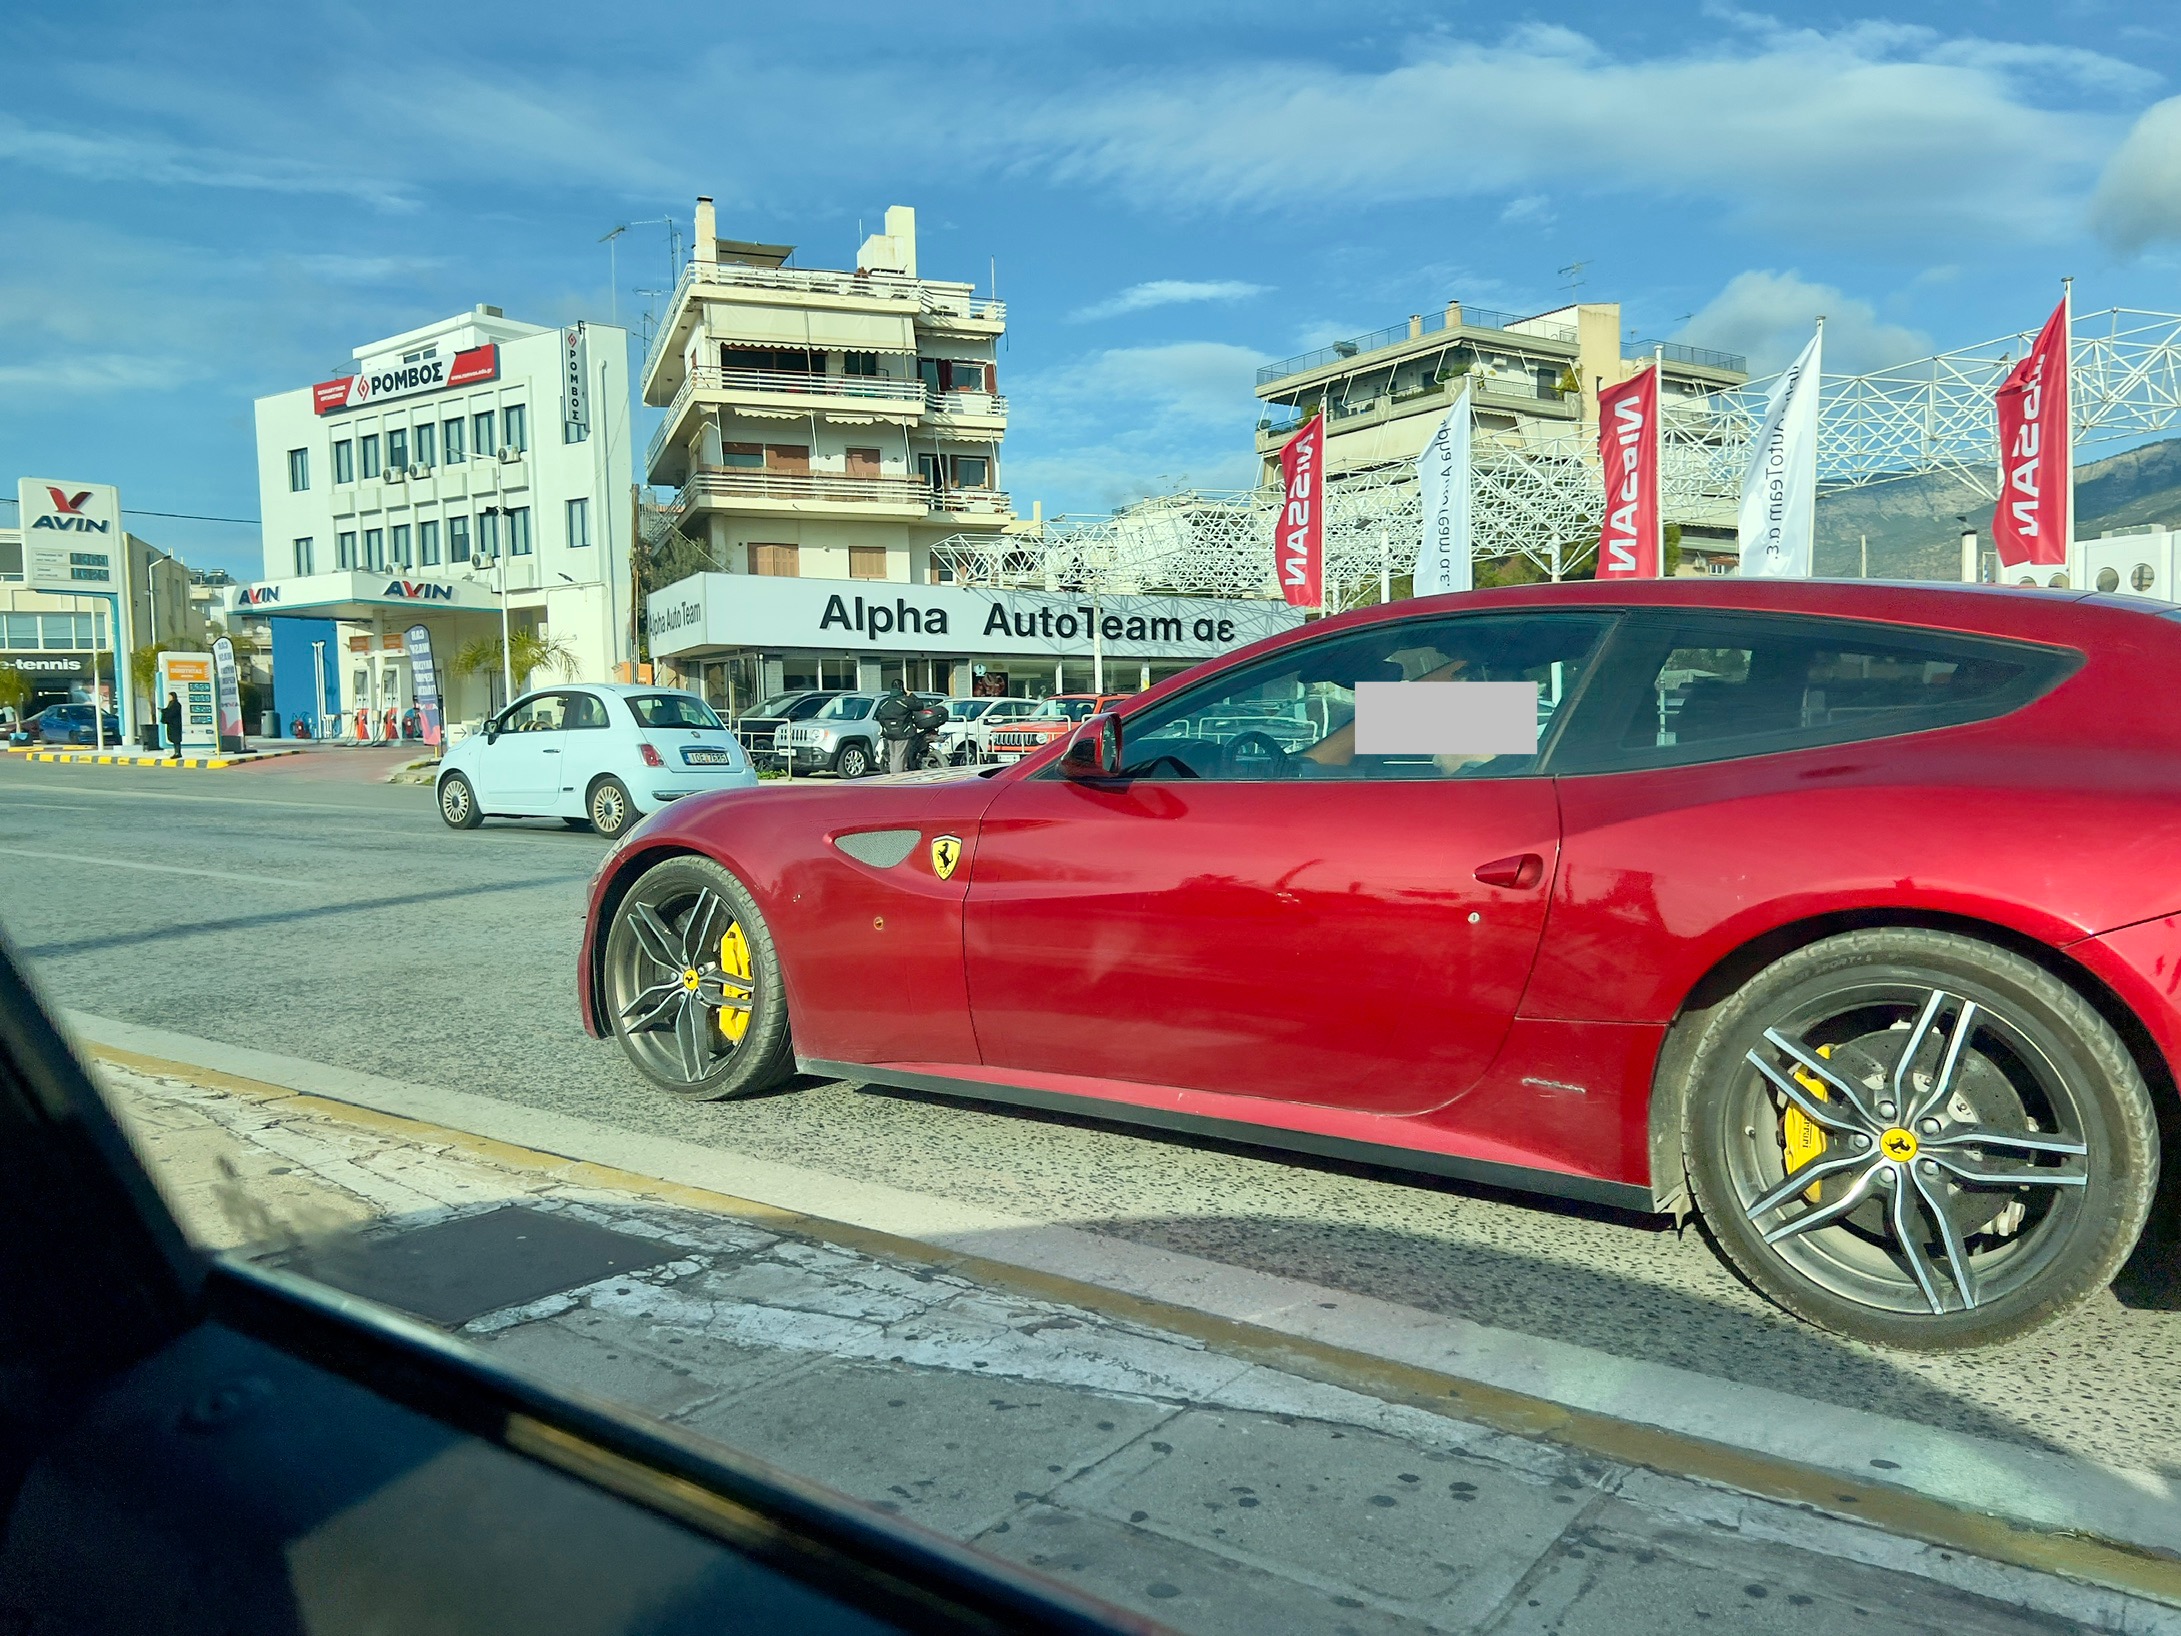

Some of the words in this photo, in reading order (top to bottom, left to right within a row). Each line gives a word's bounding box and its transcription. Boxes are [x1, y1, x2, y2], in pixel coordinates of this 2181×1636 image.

[371, 361, 443, 396] ΡΟΜΒΟΣ
[569, 349, 579, 420] ΡΟΜΒΟΣ
[31, 515, 109, 533] AVIN
[238, 586, 279, 605] AVIN
[383, 580, 453, 600] AVIN
[667, 606, 682, 631] Auto
[681, 601, 701, 626] Team
[819, 594, 948, 640] Alpha
[983, 603, 1183, 641] AutoTeam
